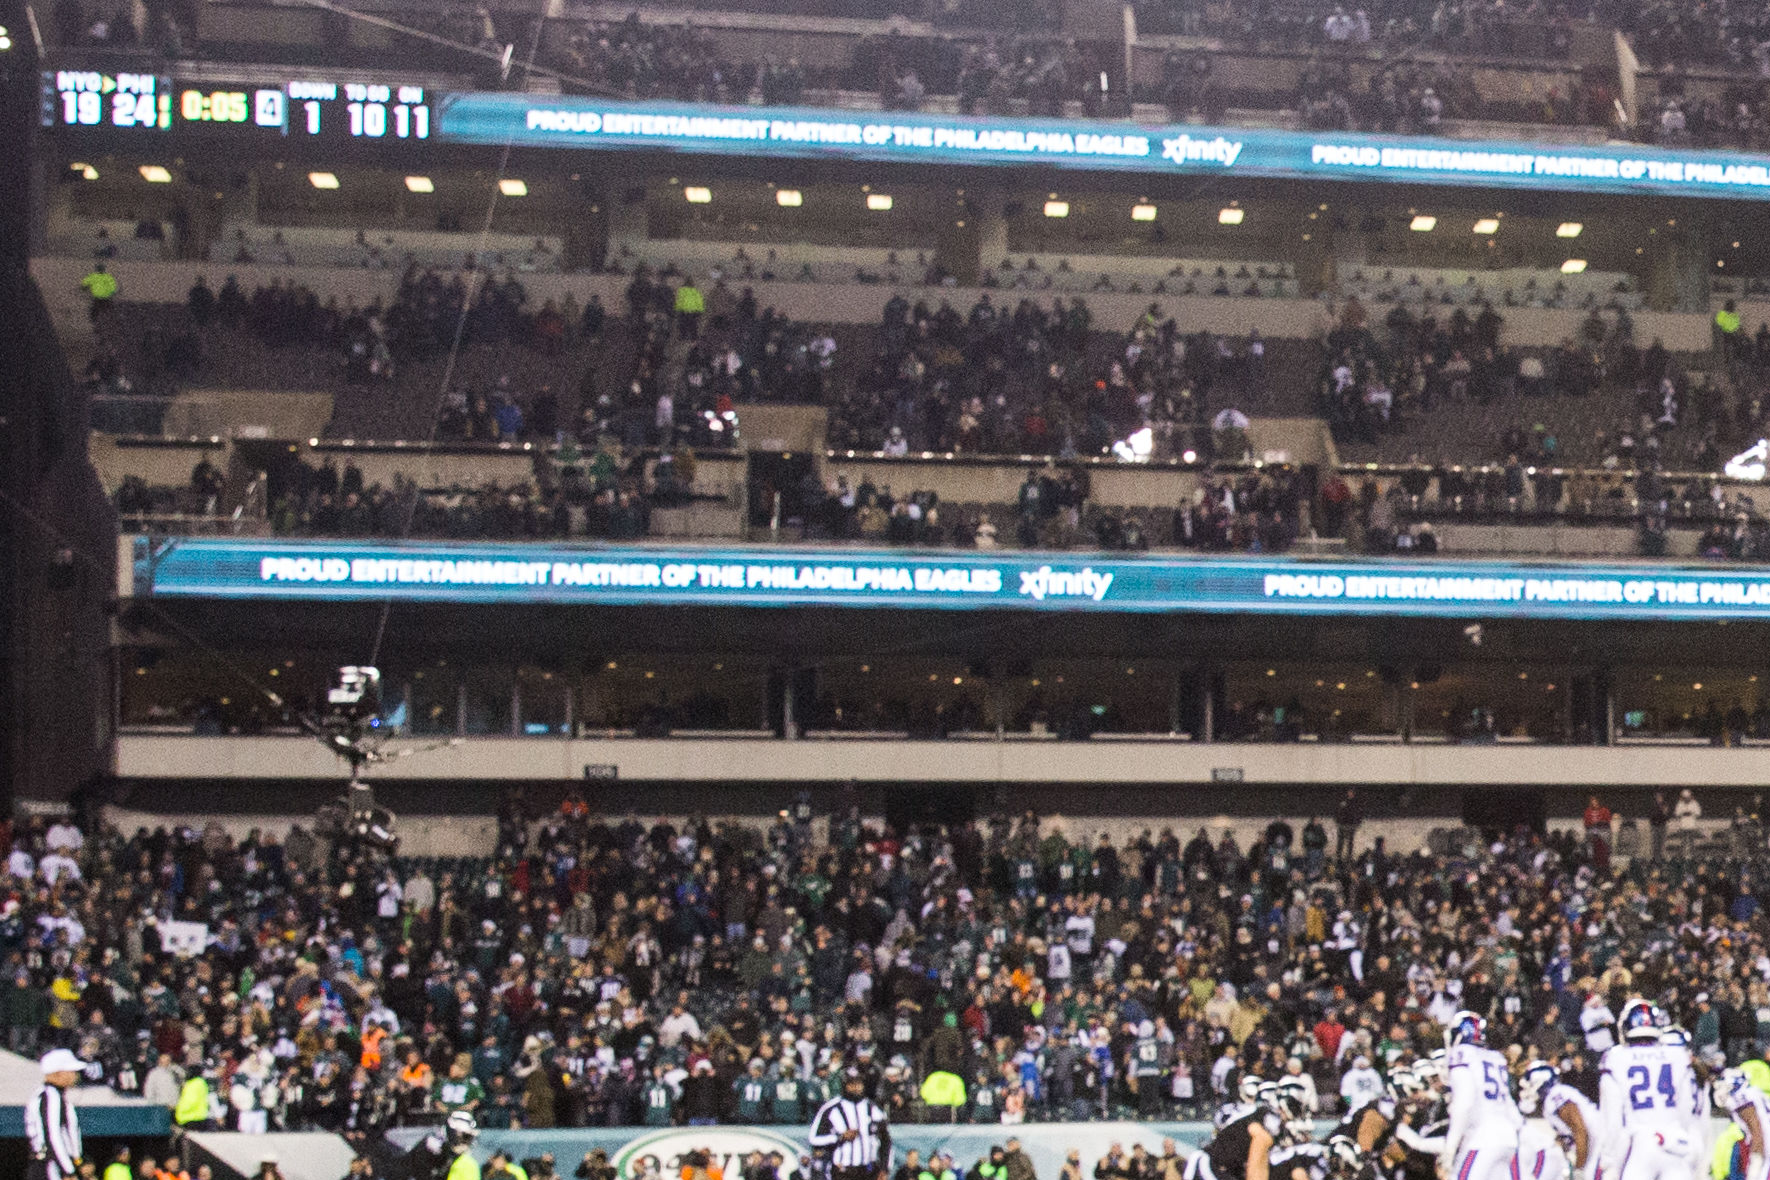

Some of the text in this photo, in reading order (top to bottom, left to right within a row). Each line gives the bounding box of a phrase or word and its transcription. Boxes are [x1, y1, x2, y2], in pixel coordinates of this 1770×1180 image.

[61, 91, 157, 128] 19 24
[182, 90, 249, 122] 0:05
[304, 101, 429, 139] 1 10 11
[526, 110, 1149, 156] PROUD ENTERTAINMENT PARTNER OF THE PHILADELPHIA EAGLES
[1162, 135, 1242, 166] xfinity
[1312, 145, 1379, 166] PROUD
[1381, 148, 1534, 174] ENTERTAINMENT
[1535, 156, 1618, 178] PARTNER
[1619, 160, 1646, 179] OF
[1647, 161, 1683, 181] THE
[261, 557, 1002, 592] PROUD ENTERTAINMENT PARTNER OF THE PHILADELPHIA EAGLES
[1019, 566, 1114, 601] xfinity
[1264, 574, 1344, 597] PROUD
[1346, 576, 1524, 601] ENTERTAINMENT
[1525, 579, 1622, 602] PARTNER
[1623, 581, 1656, 602] OF
[1657, 582, 1698, 603] THE
[1627, 1063, 1676, 1111] 24
